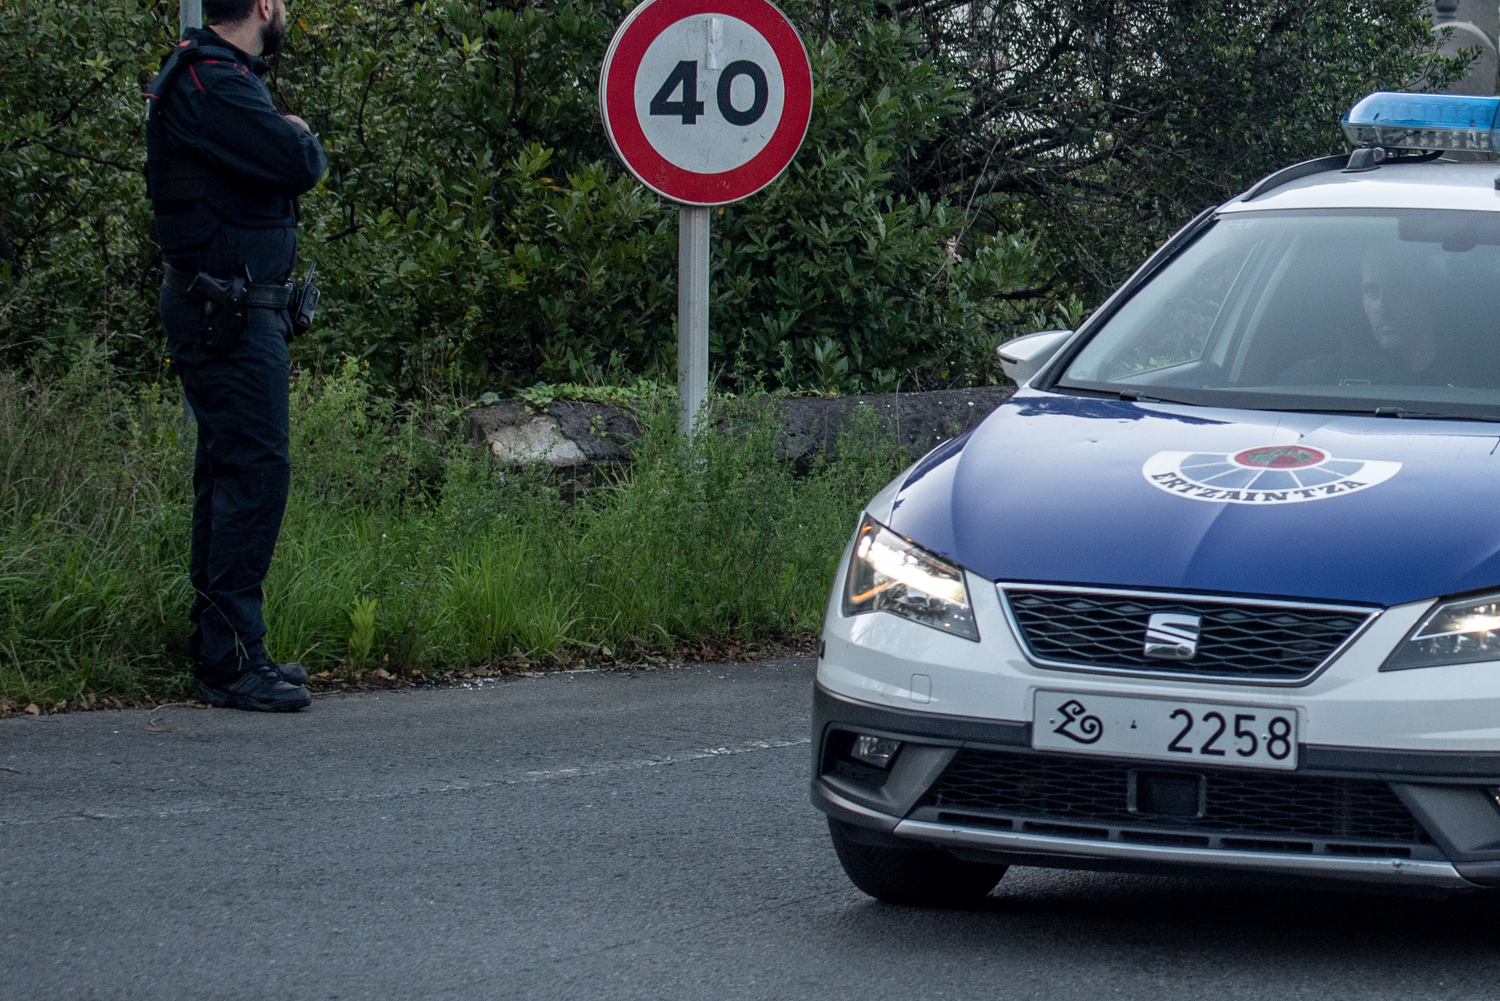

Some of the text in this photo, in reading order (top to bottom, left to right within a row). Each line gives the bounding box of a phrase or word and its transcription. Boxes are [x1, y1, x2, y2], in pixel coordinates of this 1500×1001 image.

[649, 59, 769, 126] 40
[1151, 471, 1368, 502] ERTZAINTZA
[1167, 708, 1292, 760] 2258
